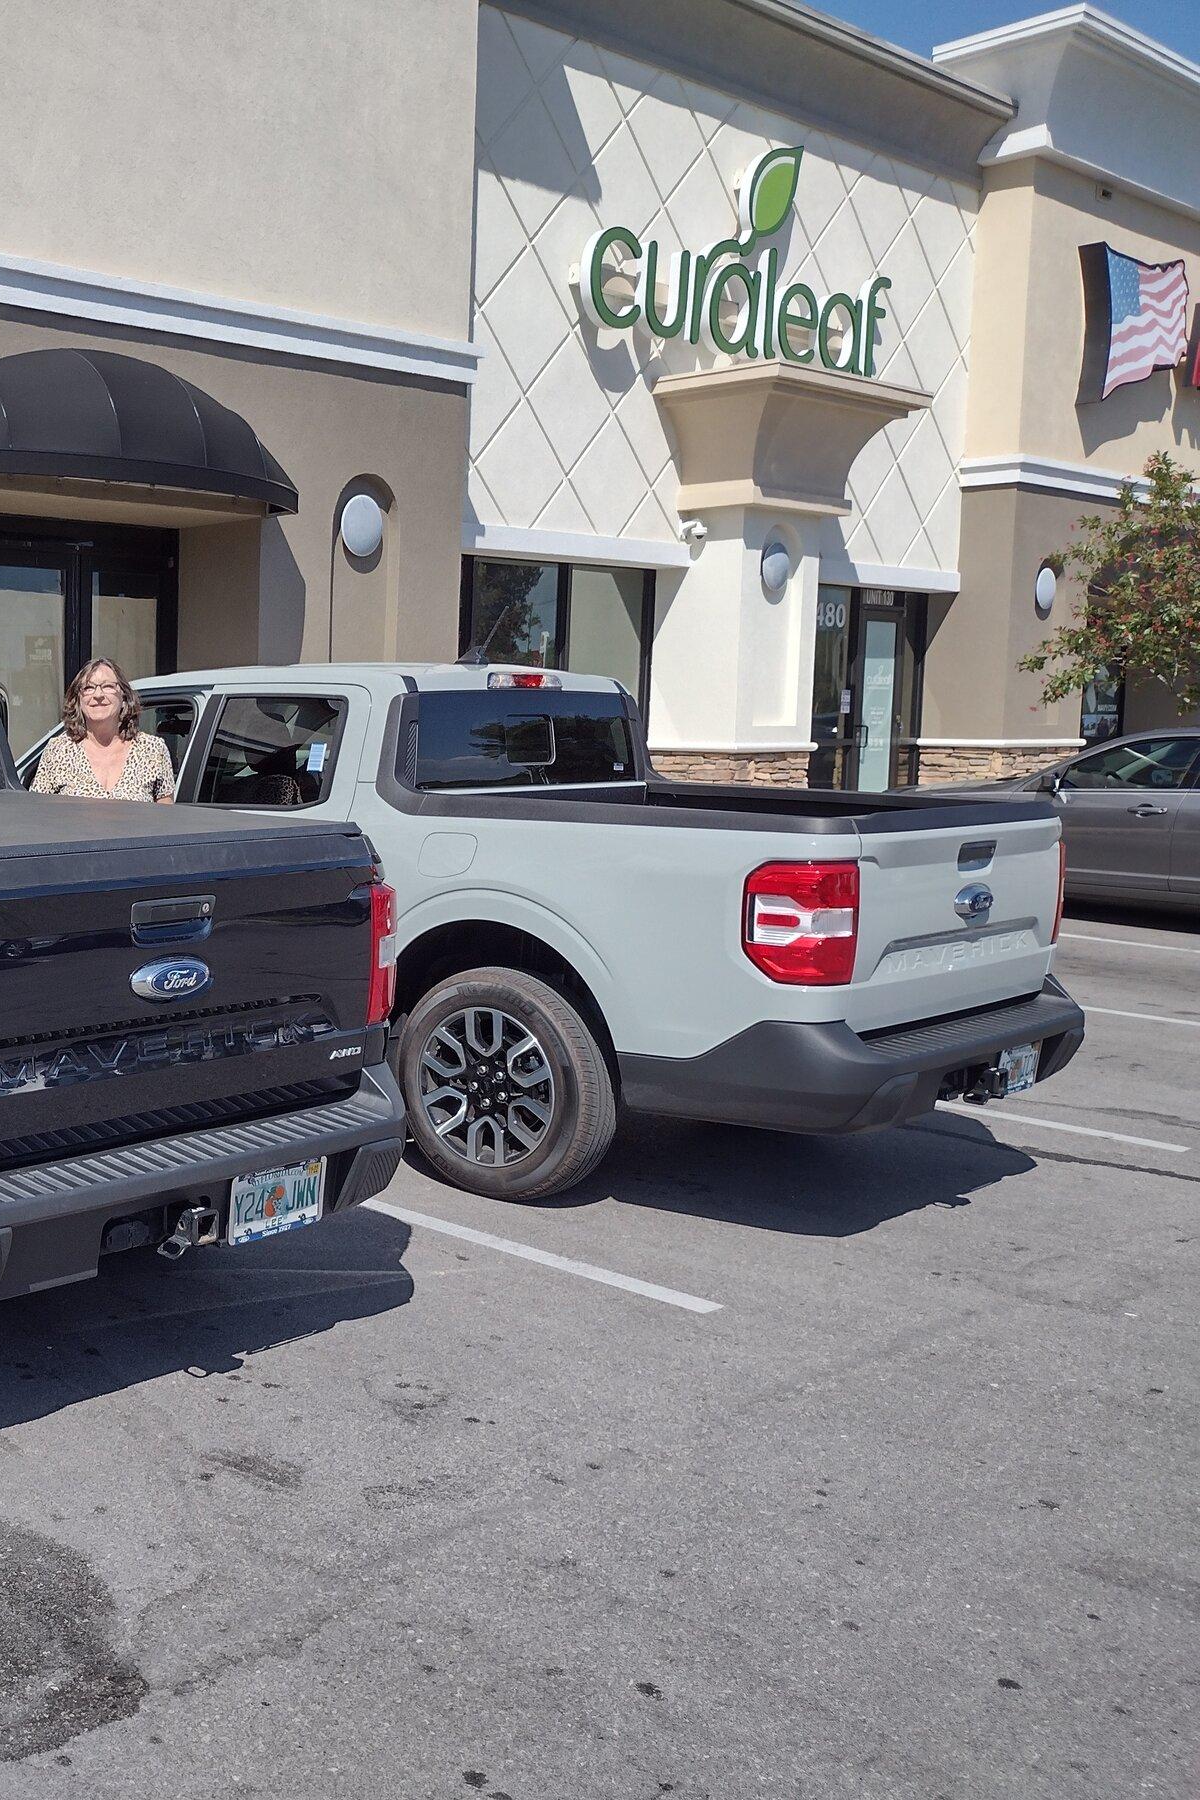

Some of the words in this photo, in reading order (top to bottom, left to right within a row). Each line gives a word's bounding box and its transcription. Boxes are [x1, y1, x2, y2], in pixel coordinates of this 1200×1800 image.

[583, 226, 892, 378] curaleaf
[866, 590, 882, 605] UNIT
[884, 931, 1027, 975] MAVERICK
[163, 969, 198, 990] Ford
[329, 1046, 362, 1060] AWD
[286, 1176, 317, 1211] JWN
[265, 1216, 283, 1229] LEE
